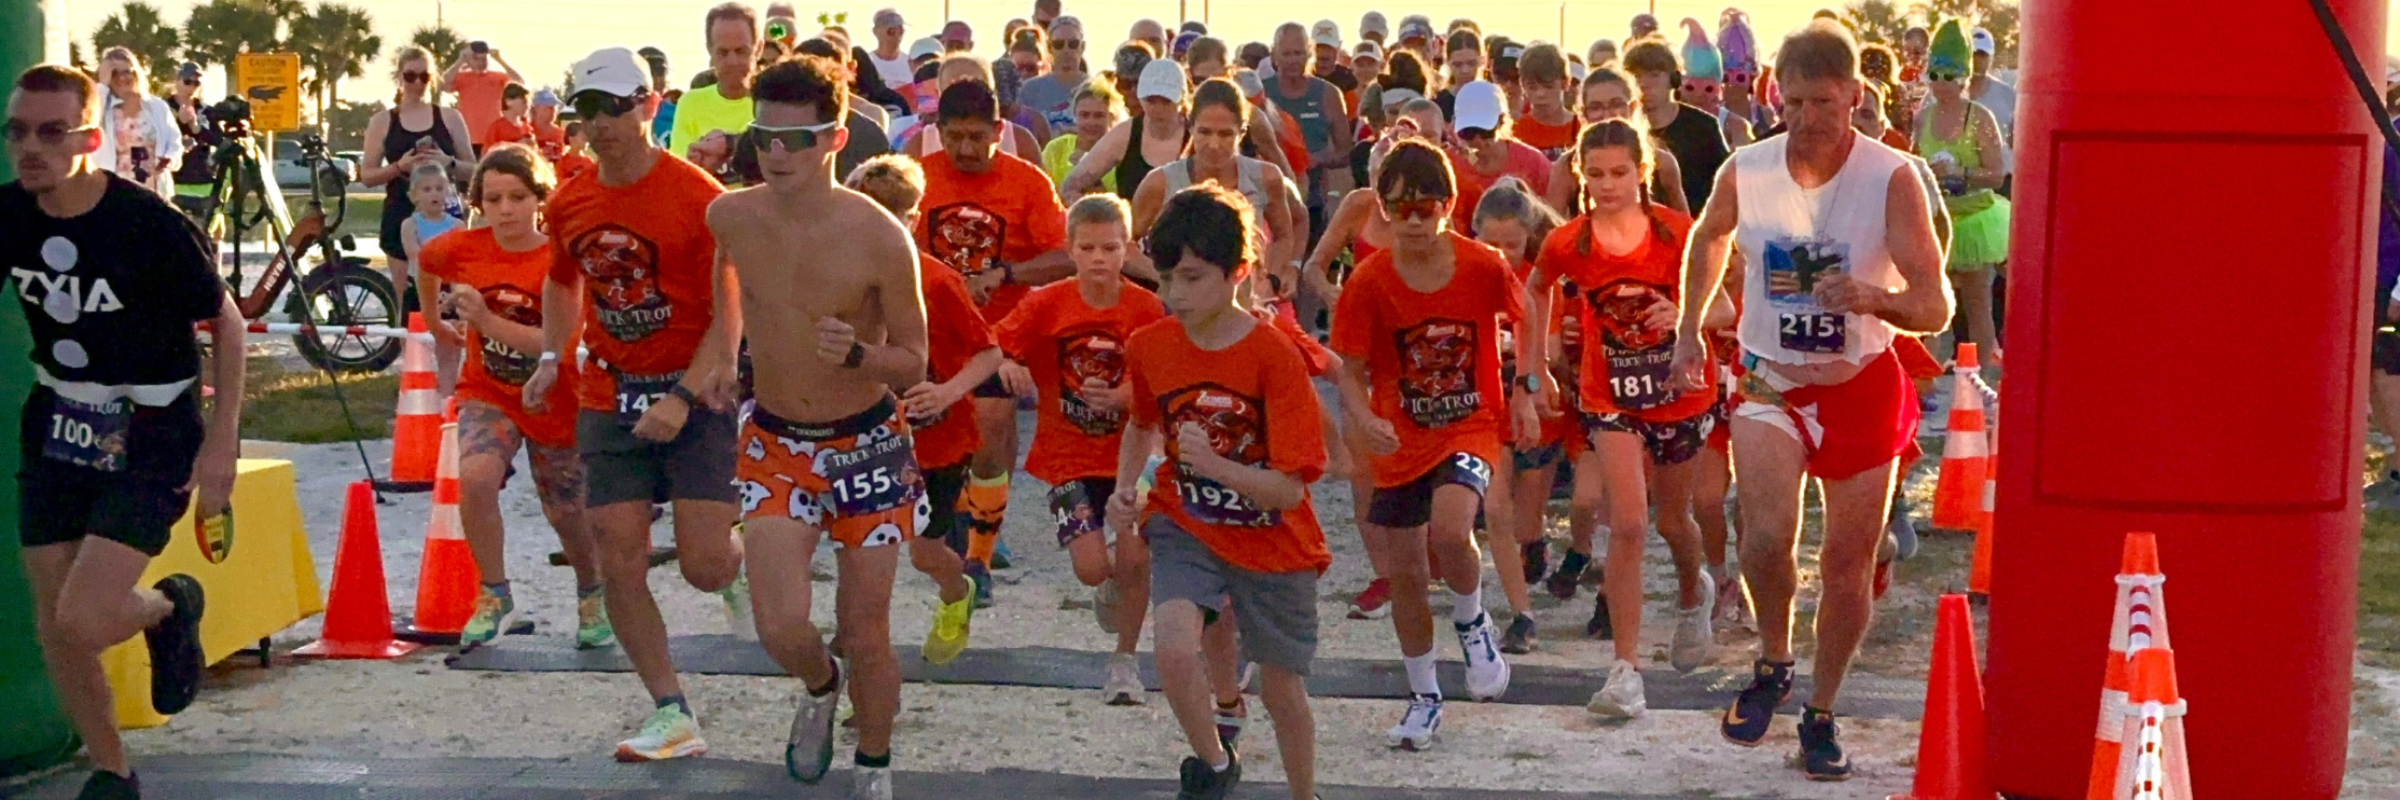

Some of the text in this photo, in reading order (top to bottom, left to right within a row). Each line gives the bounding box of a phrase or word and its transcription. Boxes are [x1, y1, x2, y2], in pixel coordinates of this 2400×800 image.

[632, 303, 674, 323] TROT
[1781, 313, 1835, 338] 215
[1609, 374, 1653, 398] 181
[1442, 391, 1481, 411] TROT
[53, 414, 93, 449] 100
[832, 433, 903, 468] TRICK TROT
[833, 466, 892, 503] 155
